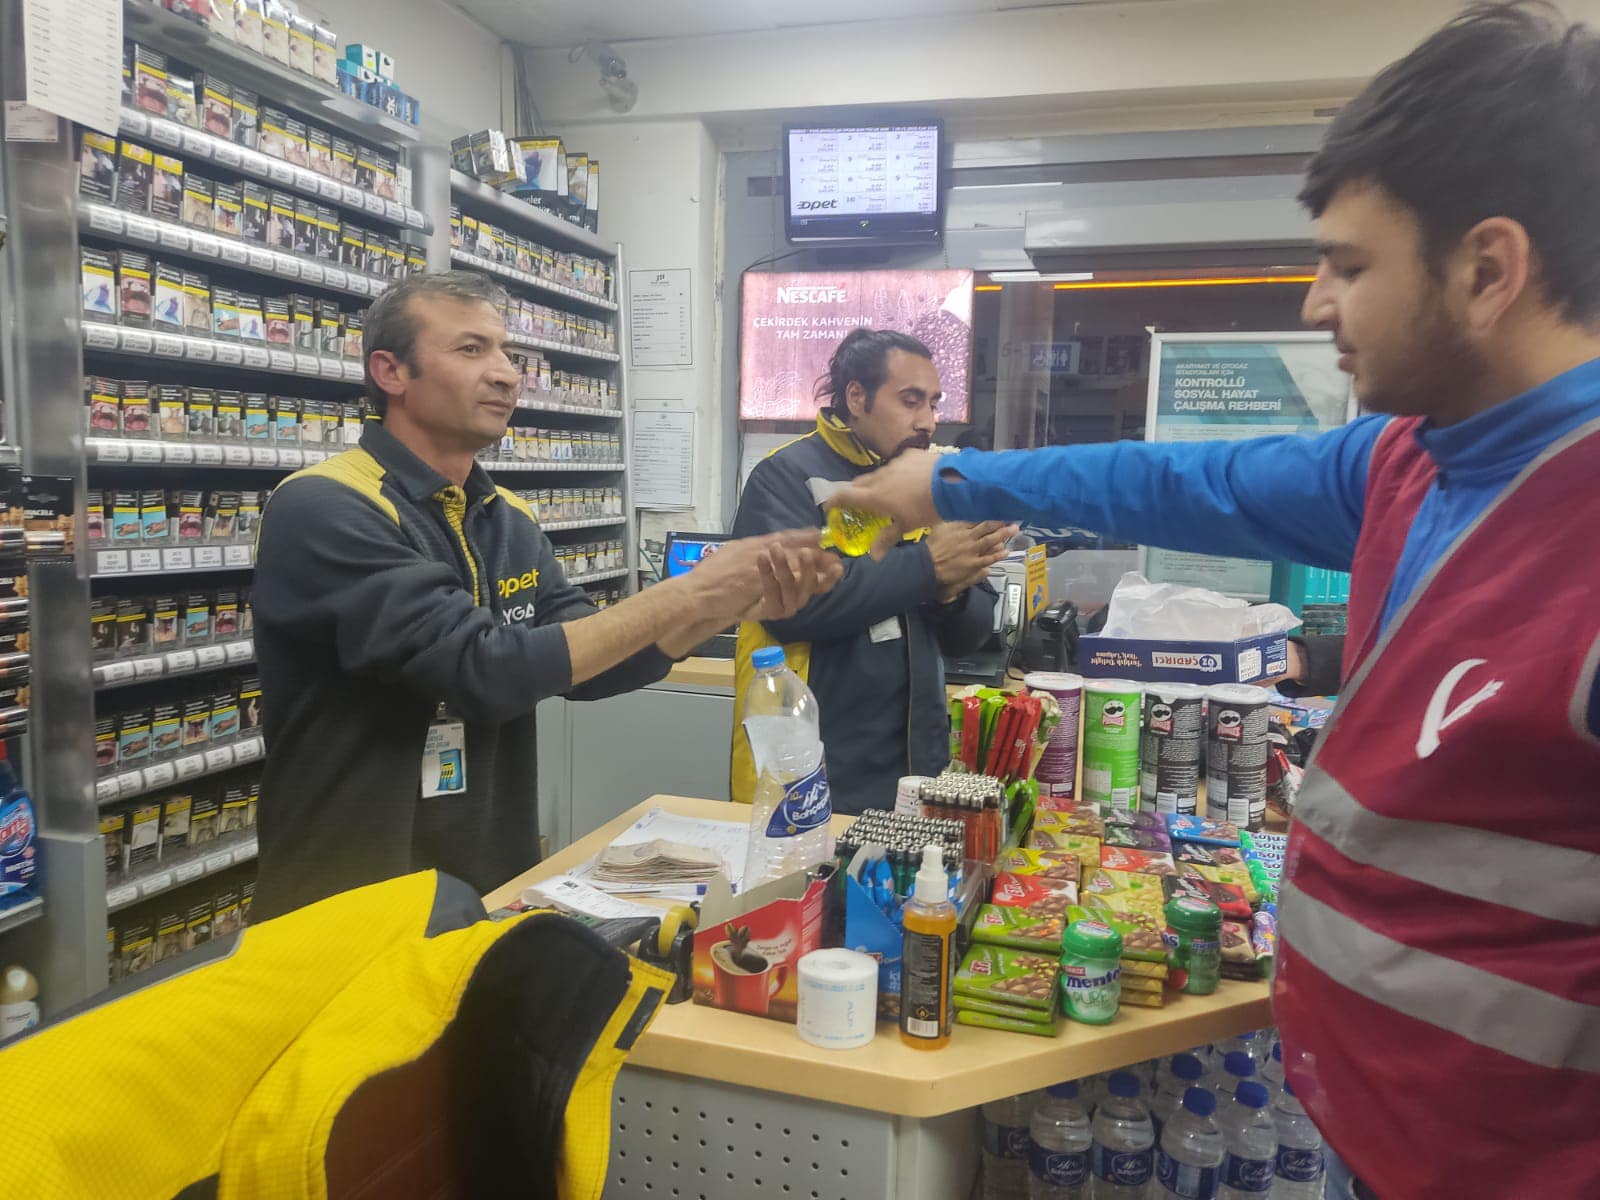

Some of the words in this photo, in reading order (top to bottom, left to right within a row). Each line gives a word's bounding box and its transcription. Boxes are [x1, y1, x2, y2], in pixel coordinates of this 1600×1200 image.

[753, 315, 809, 328] ÇEKİRDEK
[812, 315, 873, 327] KAHVENİN
[776, 330, 799, 340] TAM
[1175, 376, 1245, 388] KONTROLLÜ
[1174, 389, 1218, 399] SOSYAL
[1221, 389, 1259, 399] HAYAT
[1174, 401, 1225, 412] ÇALIŞMA
[1228, 399, 1281, 411] REHBERİ
[1251, 832, 1287, 842] entos
